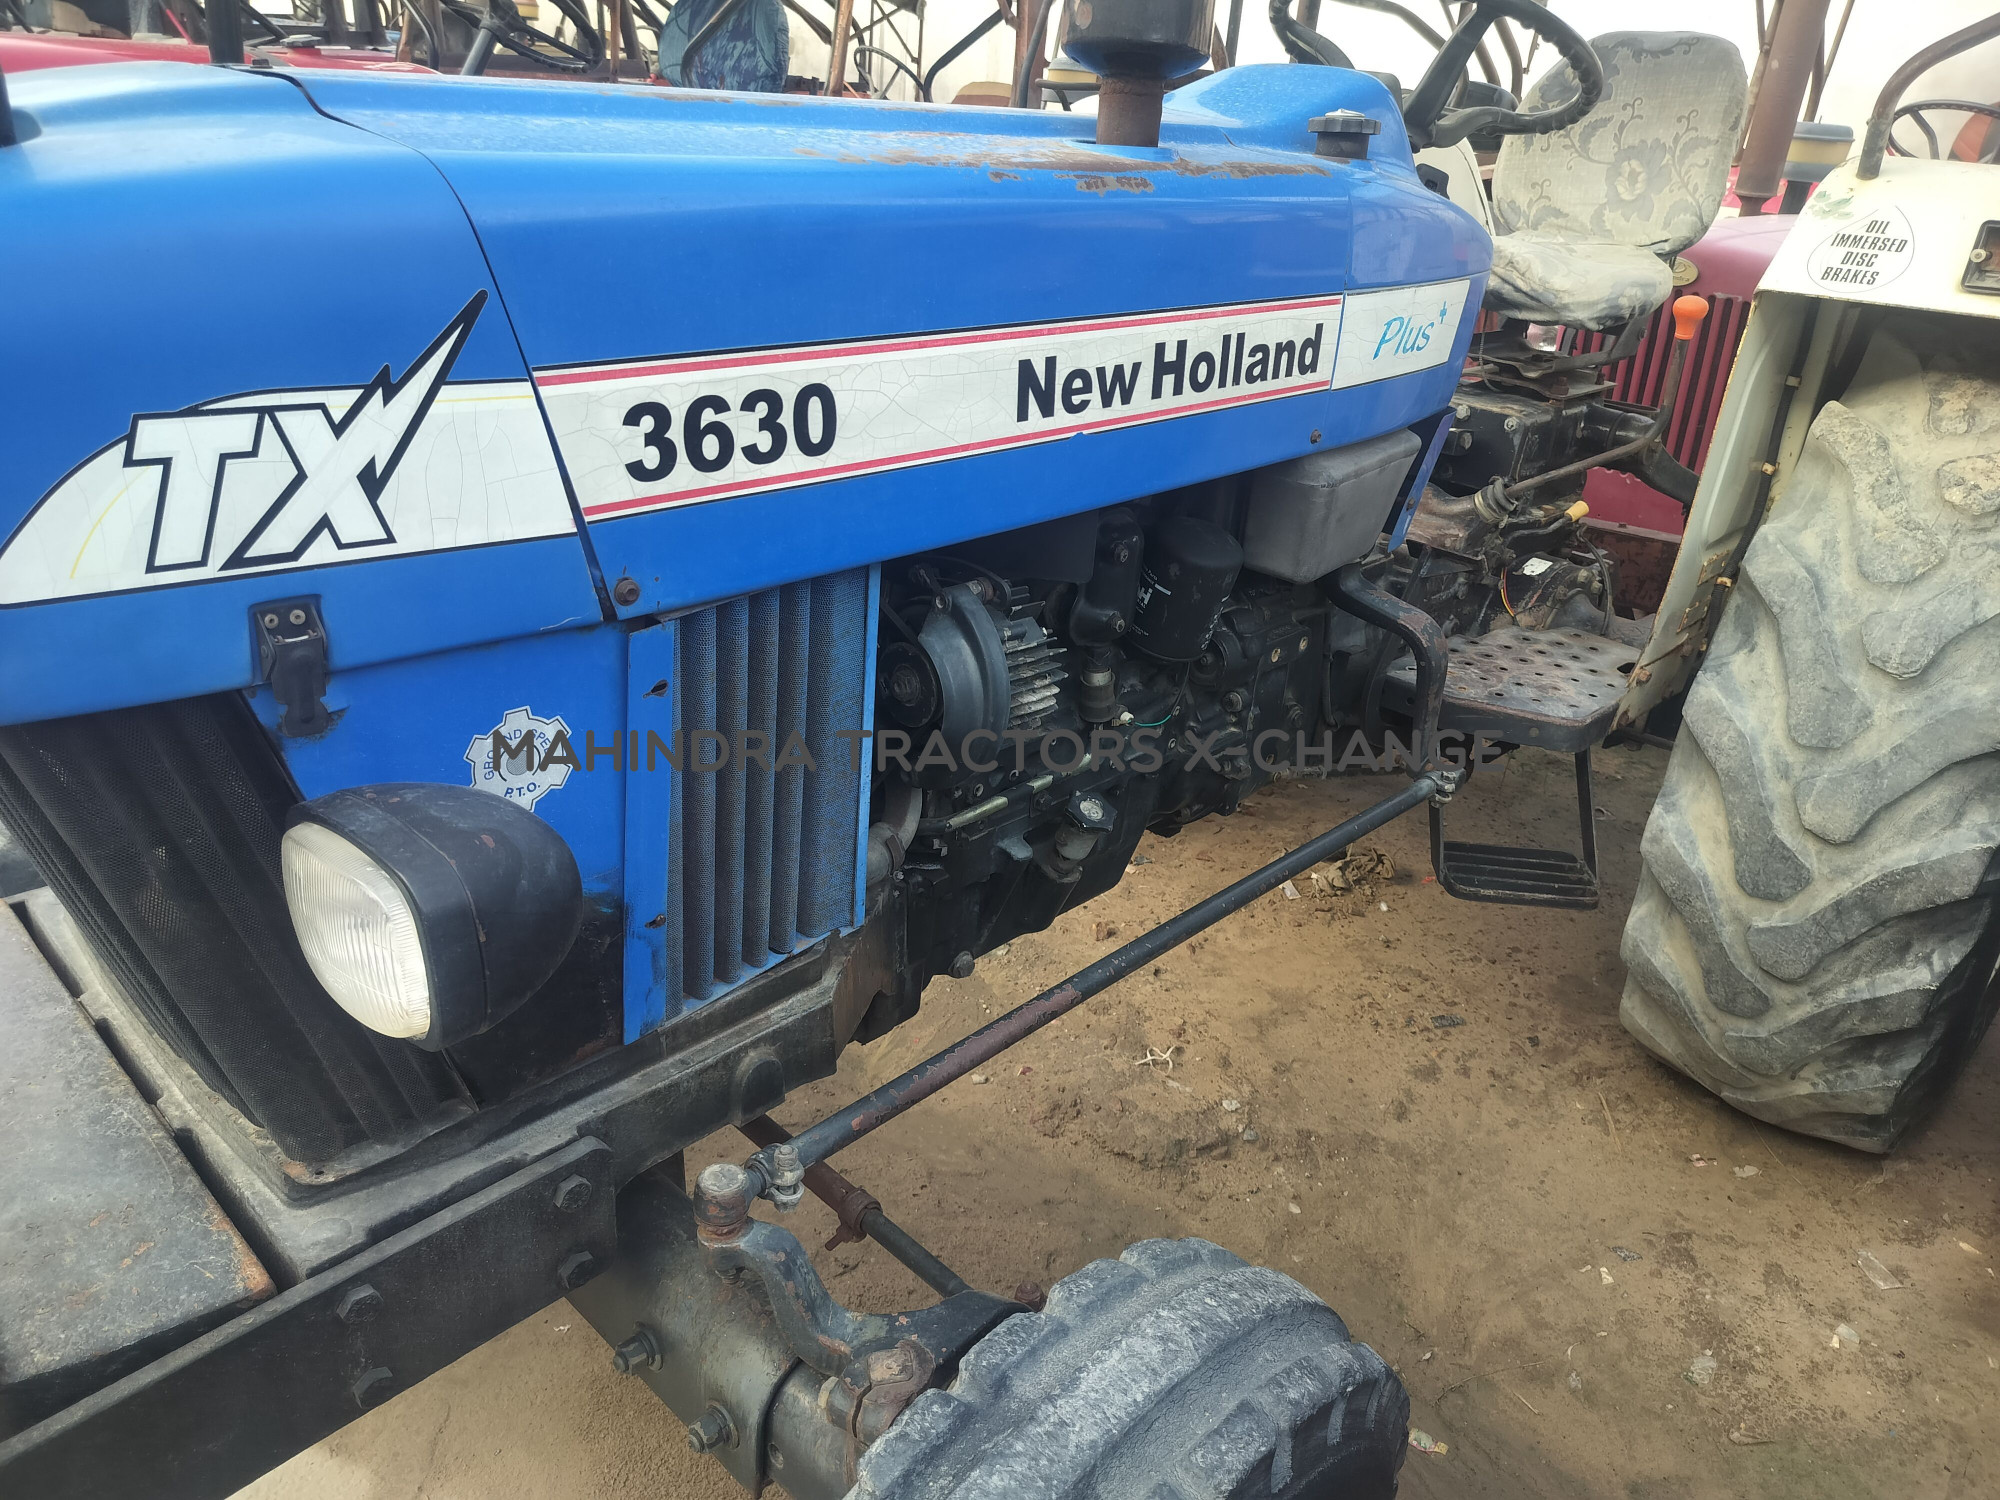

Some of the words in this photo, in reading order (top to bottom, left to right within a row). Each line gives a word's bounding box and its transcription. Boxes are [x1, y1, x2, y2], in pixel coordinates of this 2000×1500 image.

[1865, 219, 1890, 235] OIL
[1830, 232, 1908, 253] IMMERSED
[1840, 251, 1878, 268] DISC
[1820, 266, 1880, 286] BRAKES
[1016, 355, 1142, 423] New
[1151, 322, 1324, 400] Holland
[122, 288, 489, 575] TX
[622, 382, 837, 482] 3630
[503, 781, 541, 799] P.T.O.
